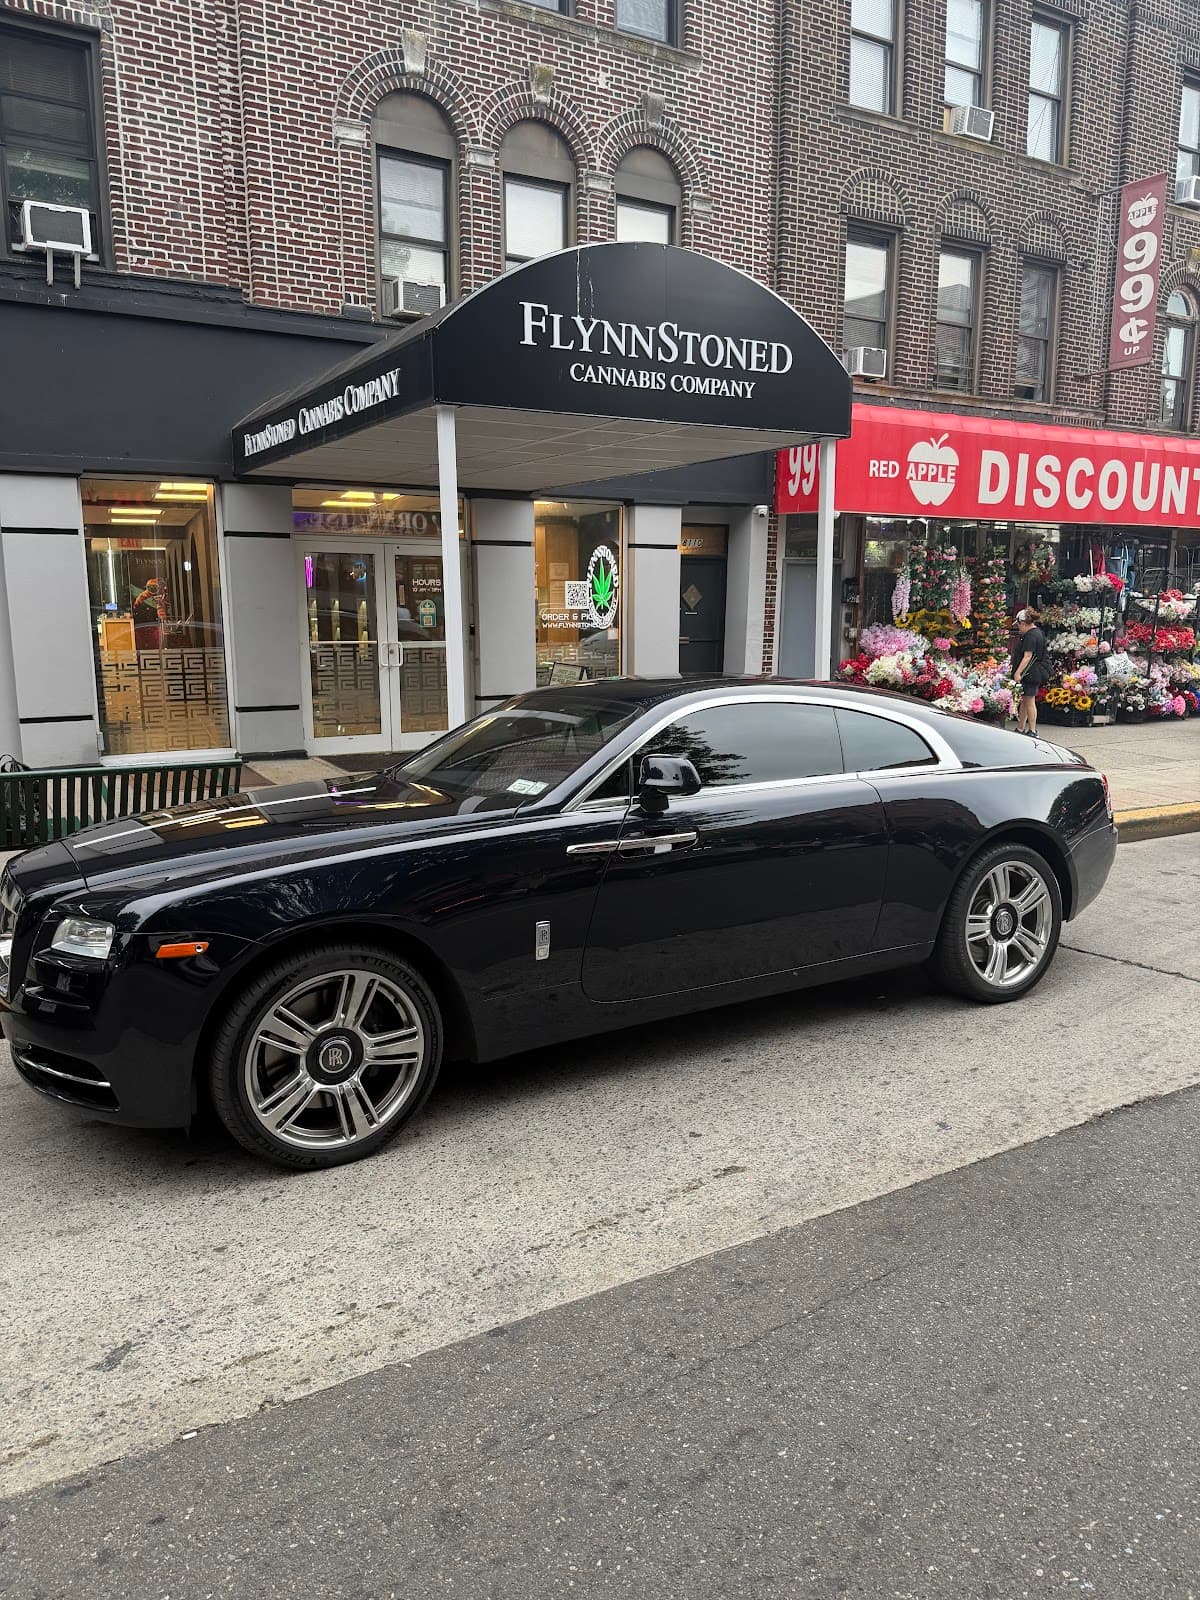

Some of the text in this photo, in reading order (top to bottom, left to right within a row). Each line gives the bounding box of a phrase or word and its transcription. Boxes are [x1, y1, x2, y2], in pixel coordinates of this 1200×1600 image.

[1127, 204, 1157, 221] APPLE
[519, 301, 793, 375] FLYNNSTONED
[1124, 346, 1140, 356] UP
[569, 362, 756, 399] CANNABIS COMPANY
[244, 367, 401, 457] FLYNNSTONED CANNABIS COMPANY
[788, 443, 821, 497] 99
[869, 459, 900, 478] RED
[906, 462, 957, 484] APPLE
[412, 578, 441, 587] HOURS
[541, 613, 569, 621] ORDER
[572, 613, 579, 621] &
